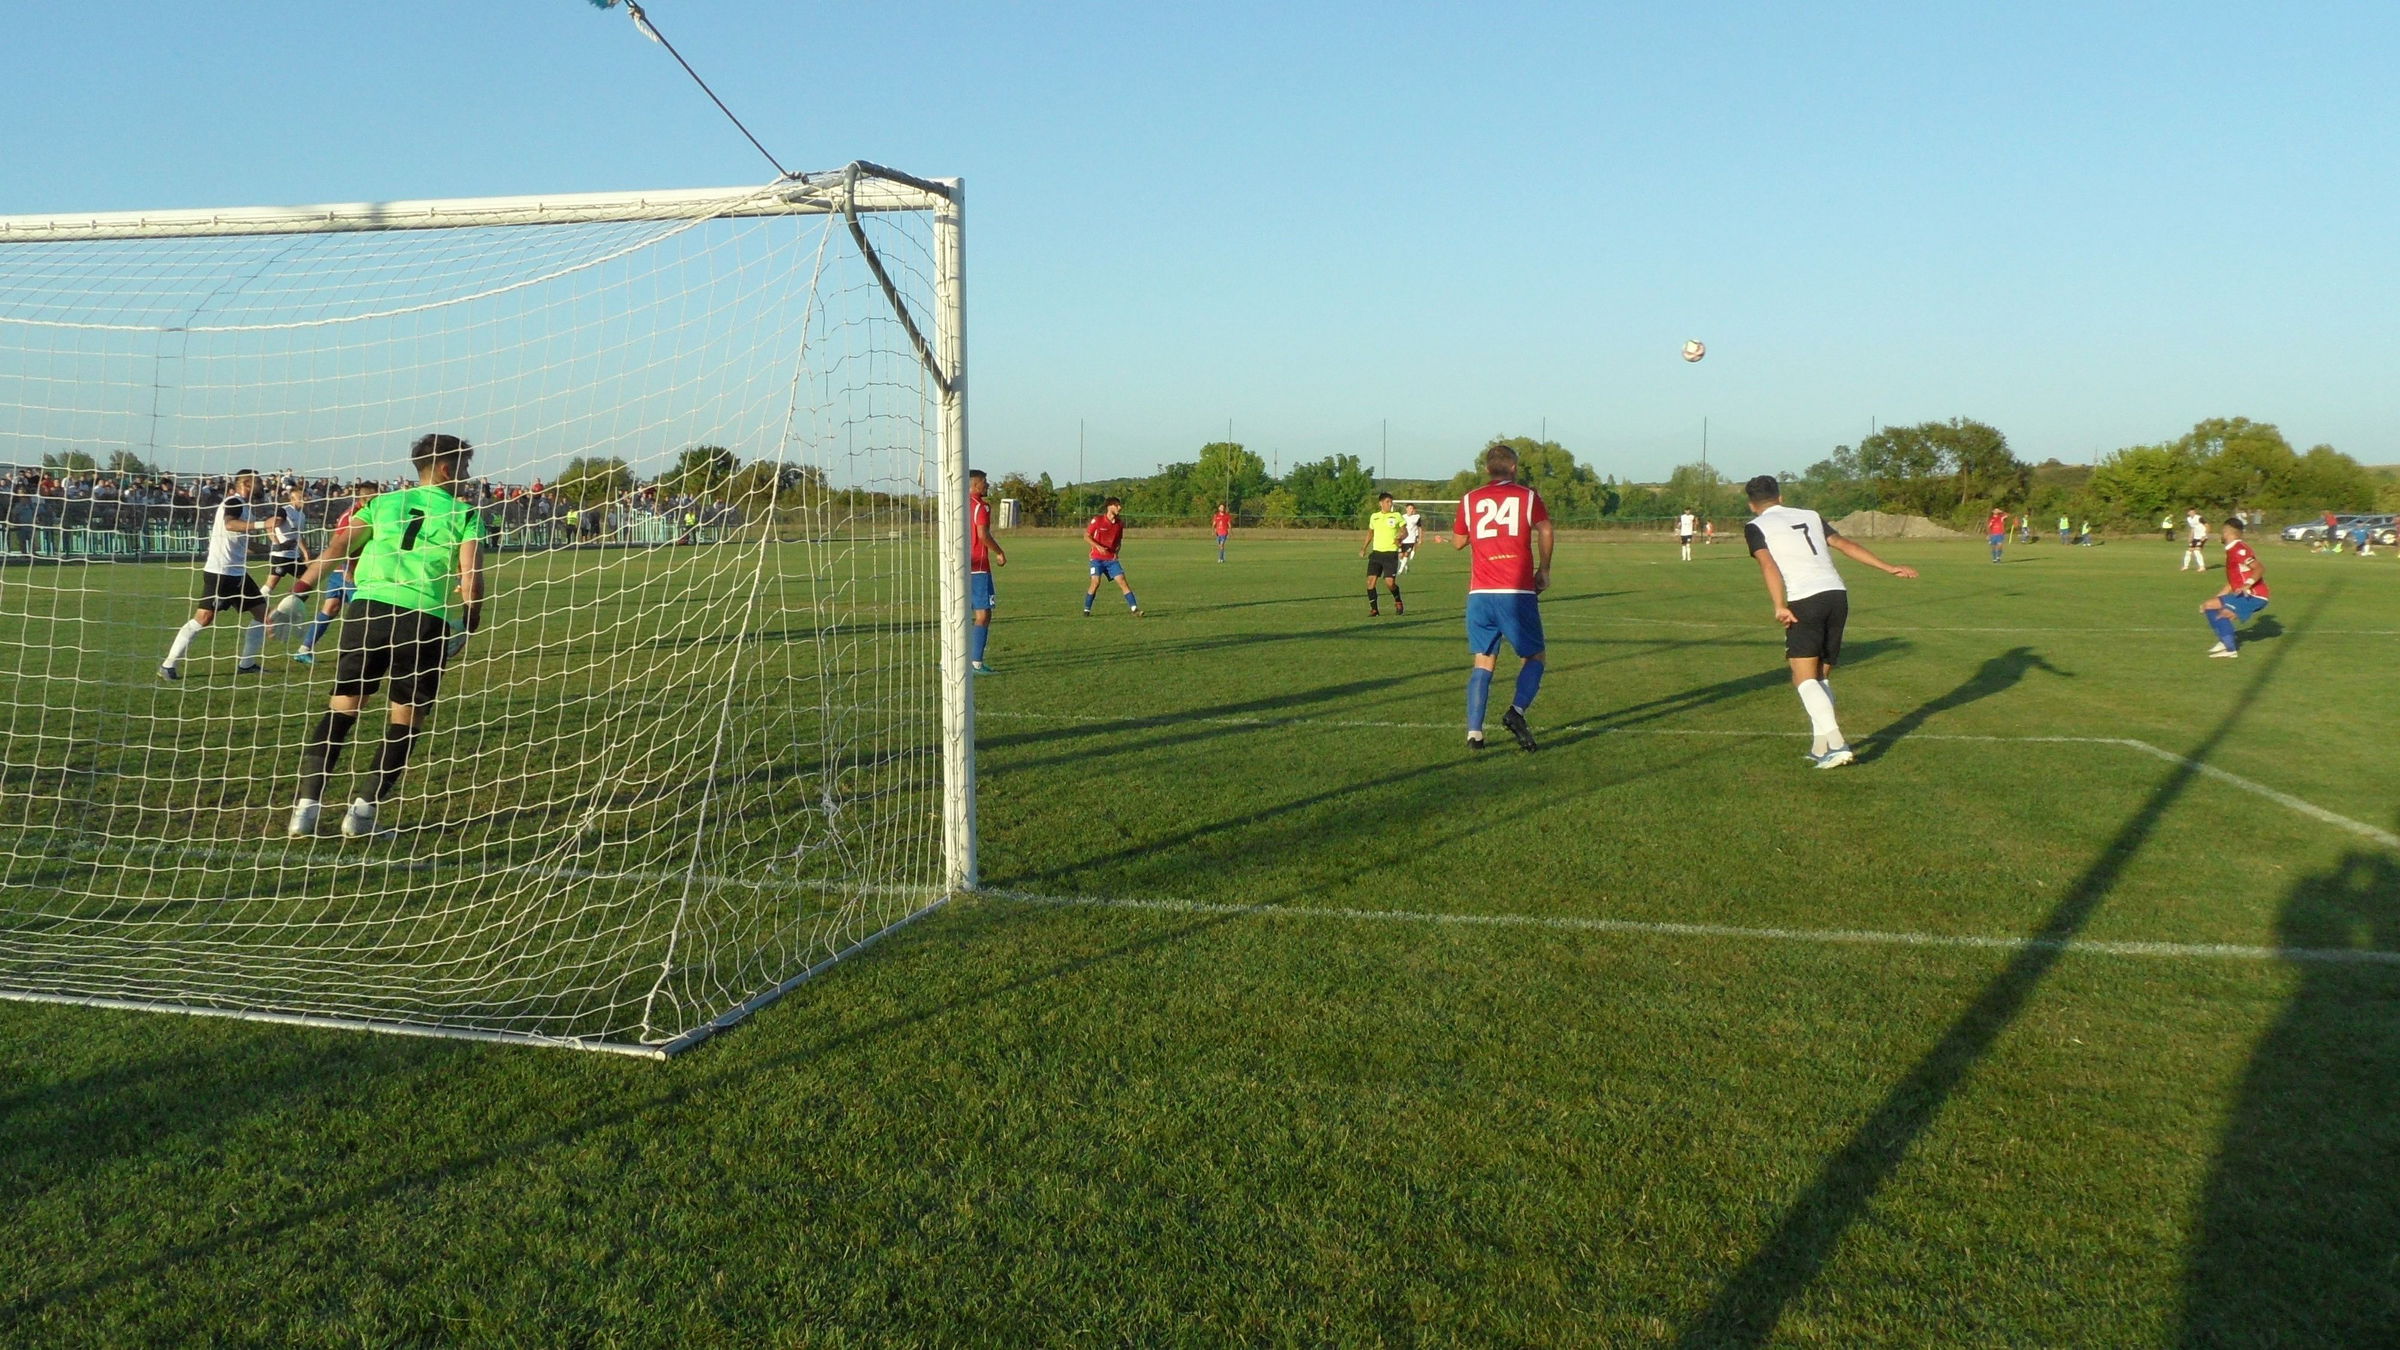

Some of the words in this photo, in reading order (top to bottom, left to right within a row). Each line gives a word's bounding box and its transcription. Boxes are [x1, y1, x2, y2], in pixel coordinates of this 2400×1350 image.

[400, 507, 425, 551] 1
[1475, 496, 1520, 540] 24
[1791, 522, 1818, 556] 7
